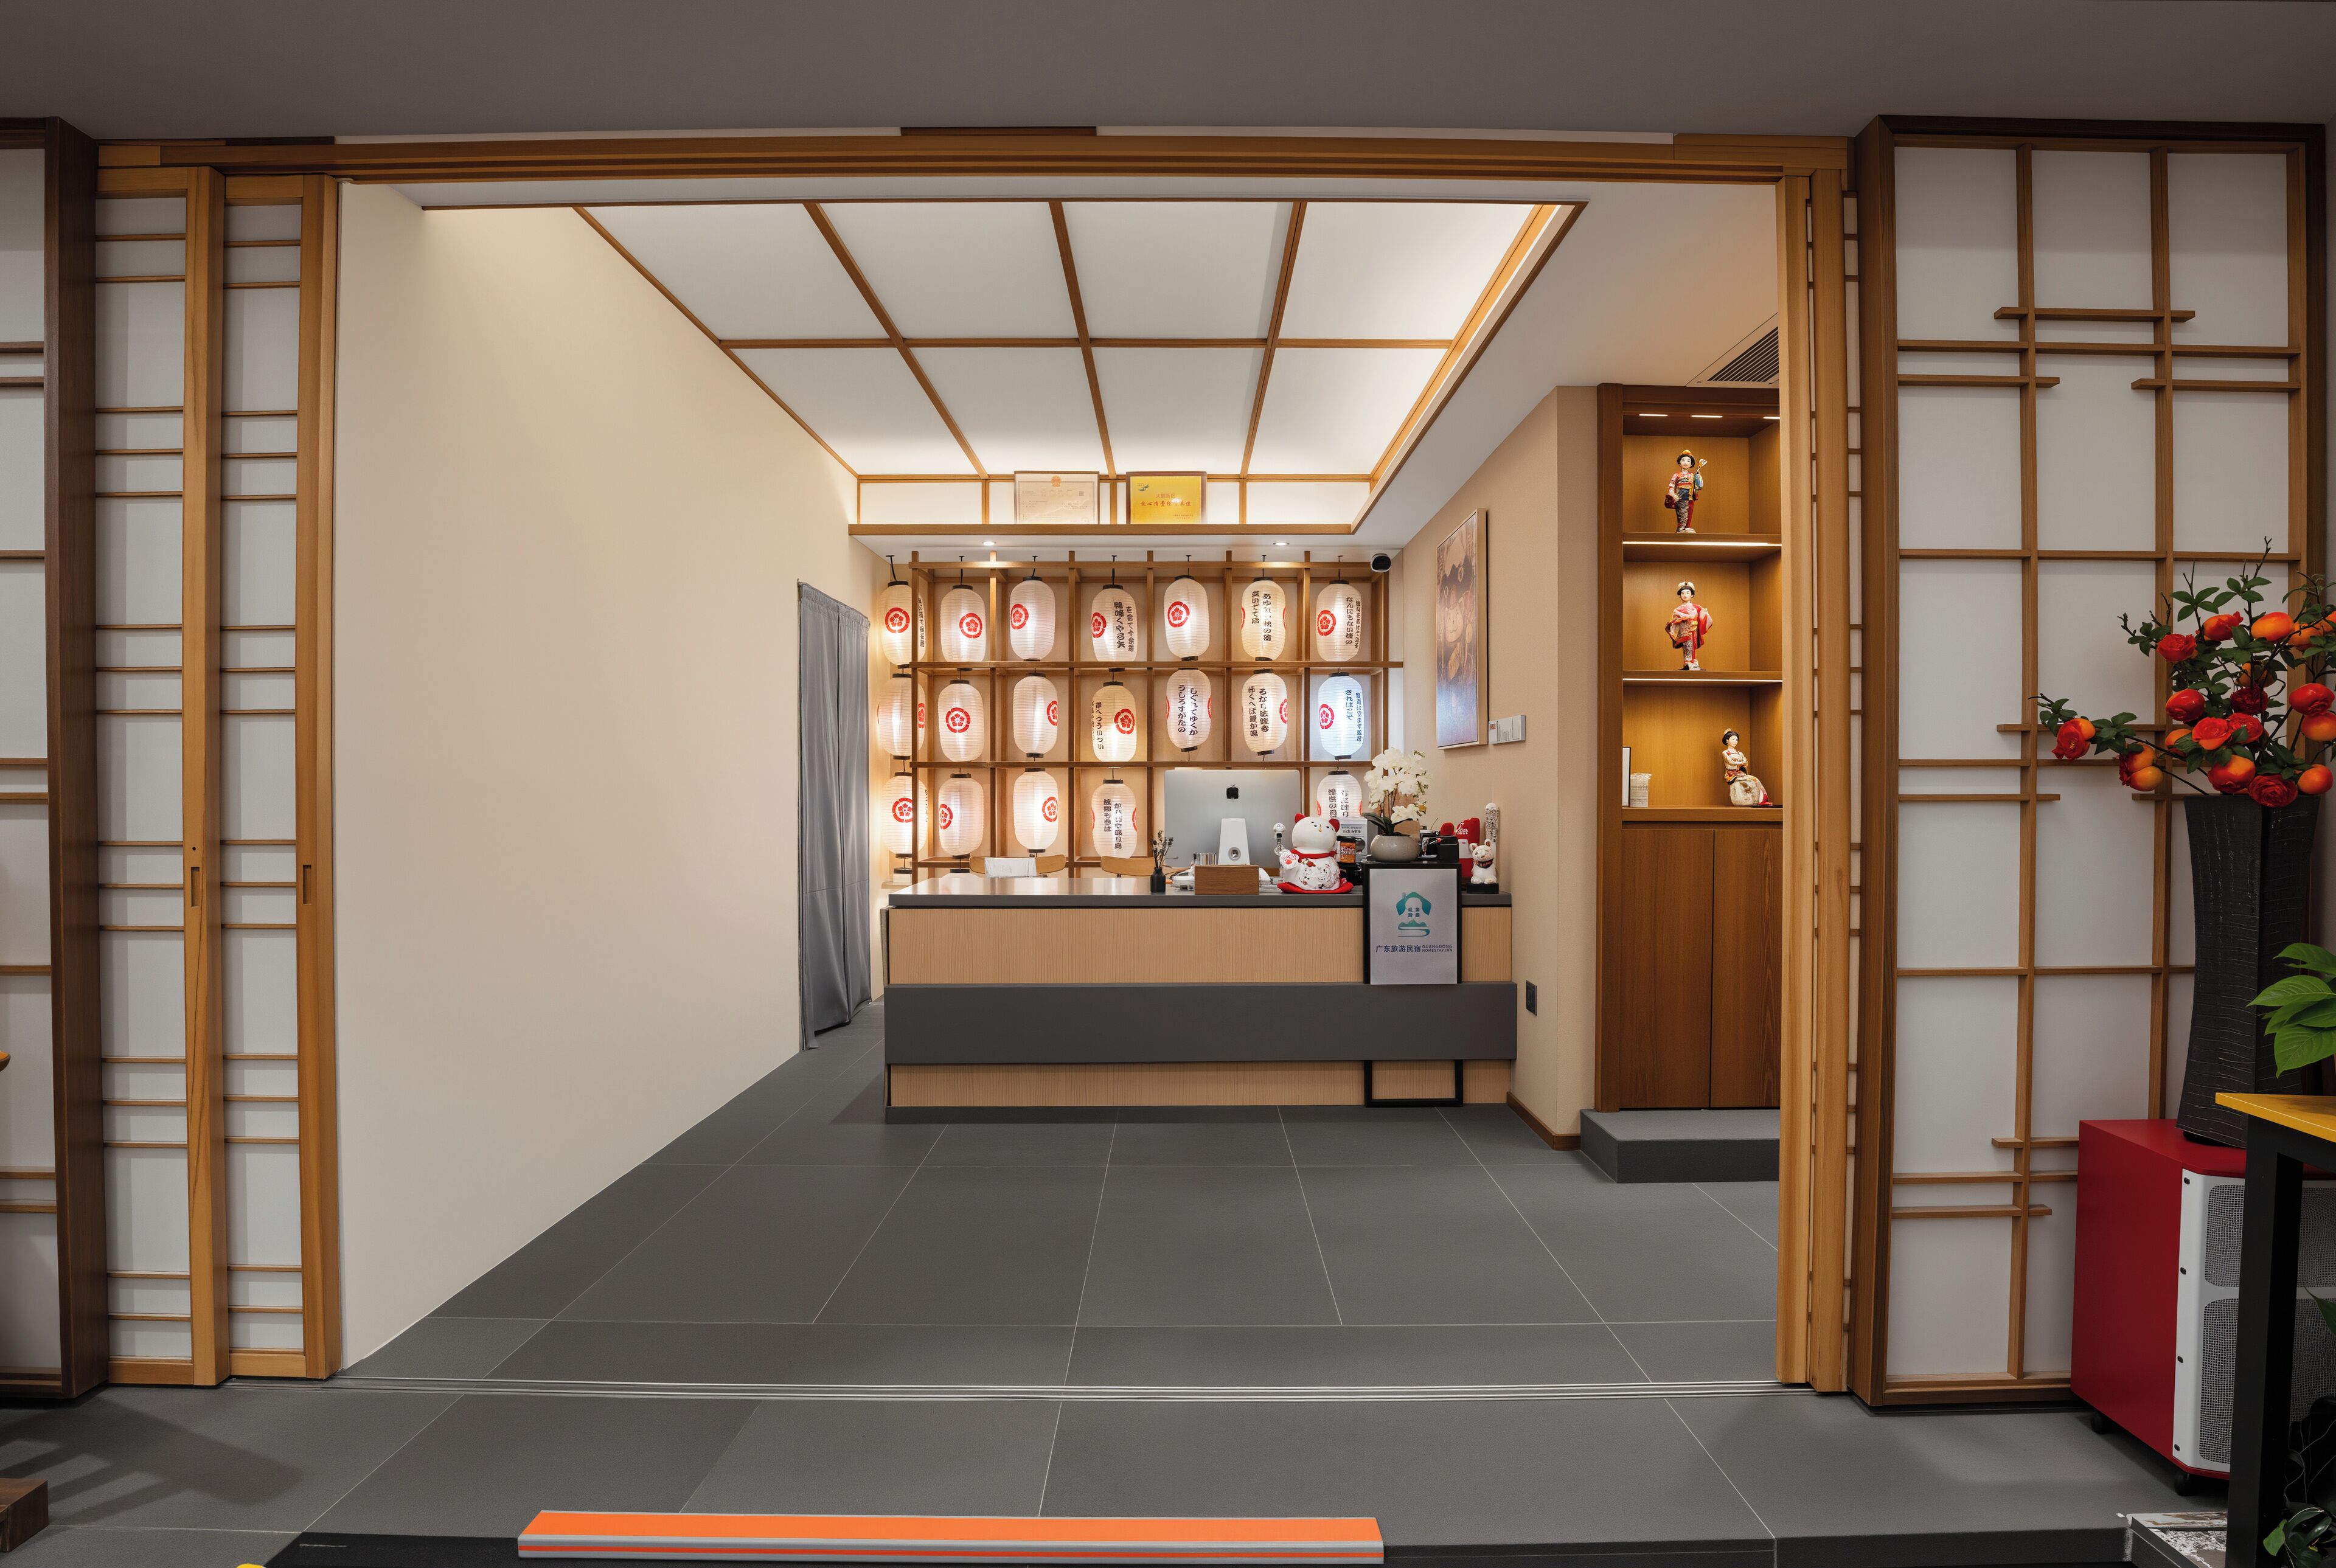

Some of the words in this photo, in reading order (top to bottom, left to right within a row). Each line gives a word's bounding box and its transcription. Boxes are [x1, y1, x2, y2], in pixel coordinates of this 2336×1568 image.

[1178, 684, 1186, 732] うしろすがたの
[1345, 690, 1354, 720] さればこそ
